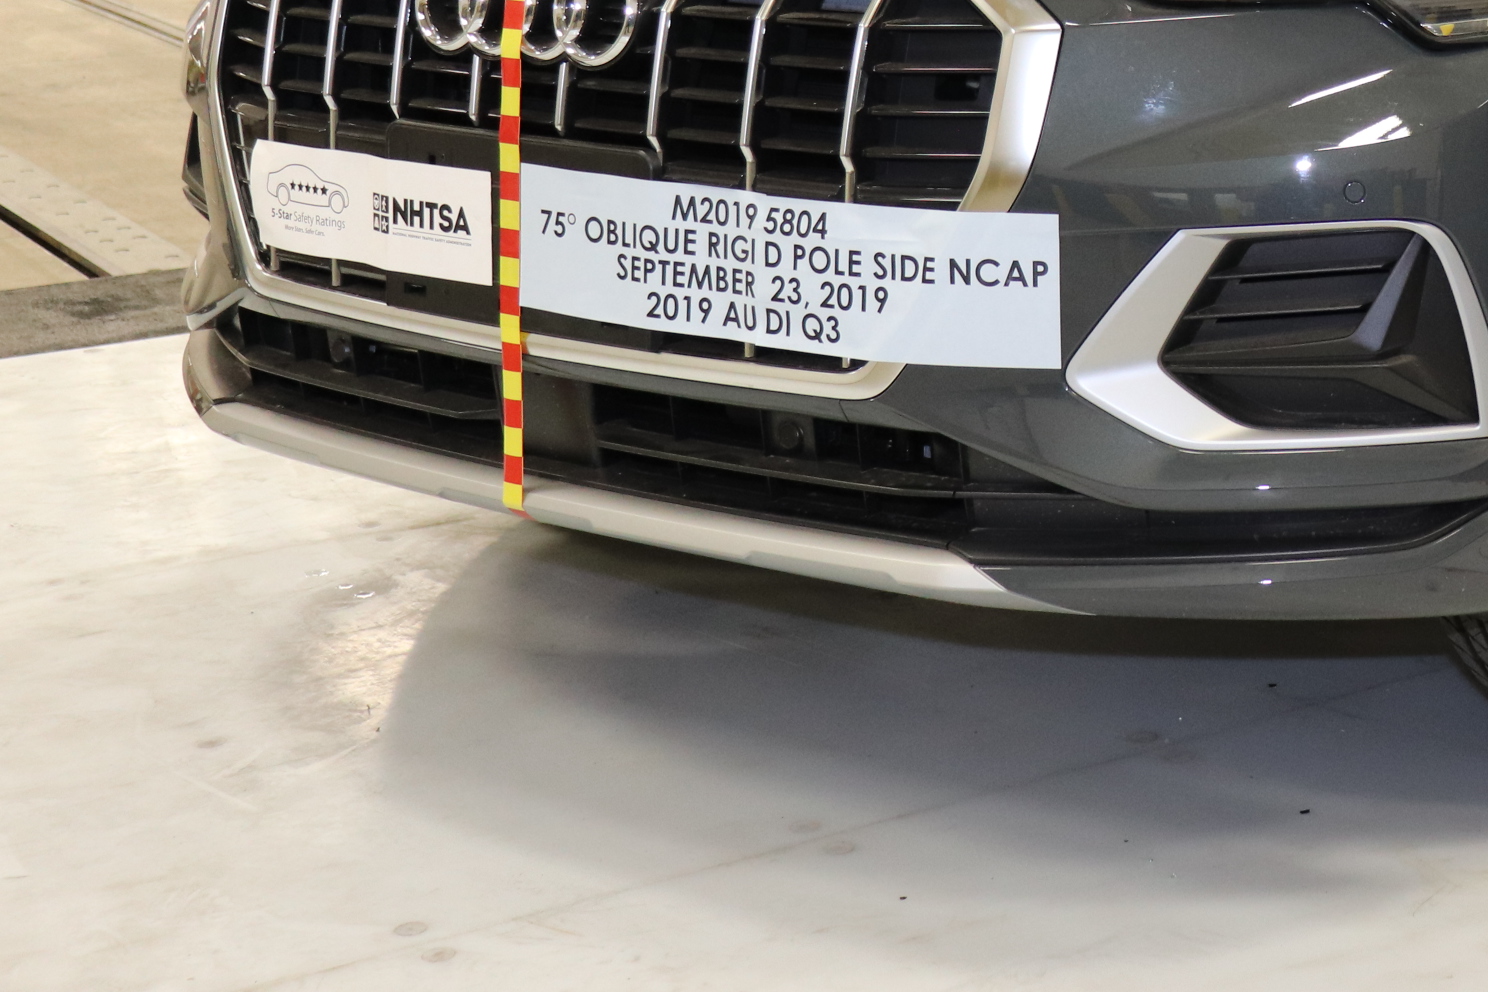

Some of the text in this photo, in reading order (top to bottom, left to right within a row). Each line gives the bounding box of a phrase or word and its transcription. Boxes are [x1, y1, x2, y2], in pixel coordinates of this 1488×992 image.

[271, 207, 346, 231] 5-Star Safety Ratings
[392, 196, 472, 236] NHTSA
[584, 216, 698, 256] OBLIQUE
[793, 246, 863, 278] POLE
[872, 253, 936, 286] SIDE
[949, 258, 1050, 289] NCAP
[616, 254, 756, 298] SEPTEMBER
[819, 282, 889, 314] 2019
[645, 293, 712, 325] 2019
[801, 313, 841, 344] Q3
